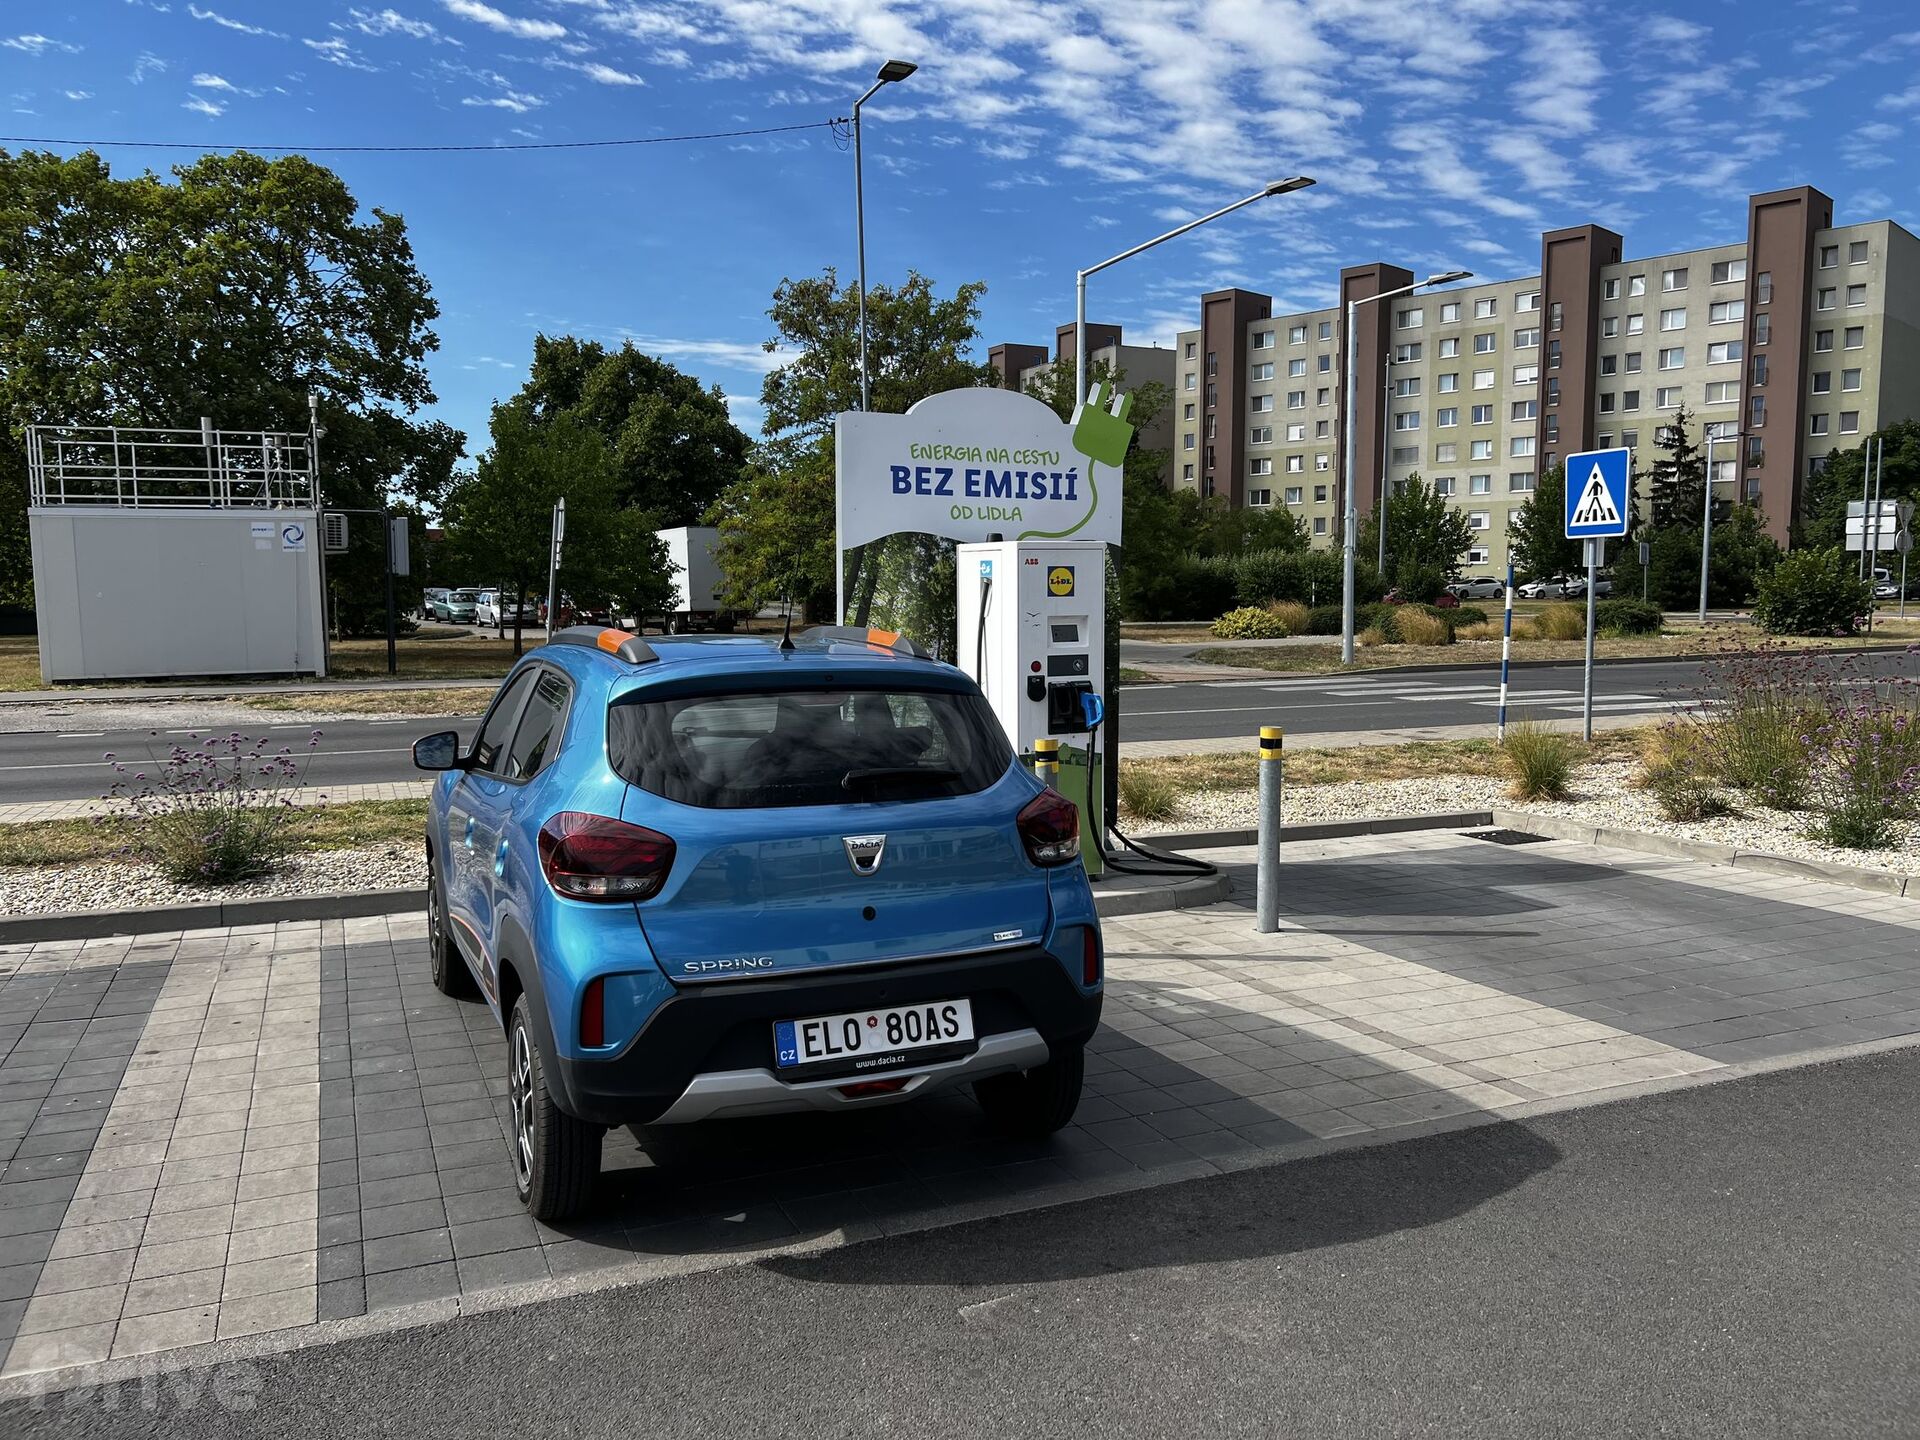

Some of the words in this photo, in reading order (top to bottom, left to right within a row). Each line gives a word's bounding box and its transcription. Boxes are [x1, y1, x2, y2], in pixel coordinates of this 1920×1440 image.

[910, 443, 983, 463] ENERGIA
[986, 447, 1008, 463] NA
[1013, 449, 1060, 466] CESTU
[890, 465, 953, 496] BEZ
[965, 467, 1078, 501] EMISIÍ
[951, 505, 973, 520] OD
[978, 506, 1022, 522] LIDLA
[851, 841, 880, 850] DACIA
[684, 956, 773, 974] SPRING
[780, 1048, 796, 1062] CZ
[855, 1054, 906, 1069] www.dacia.cz
